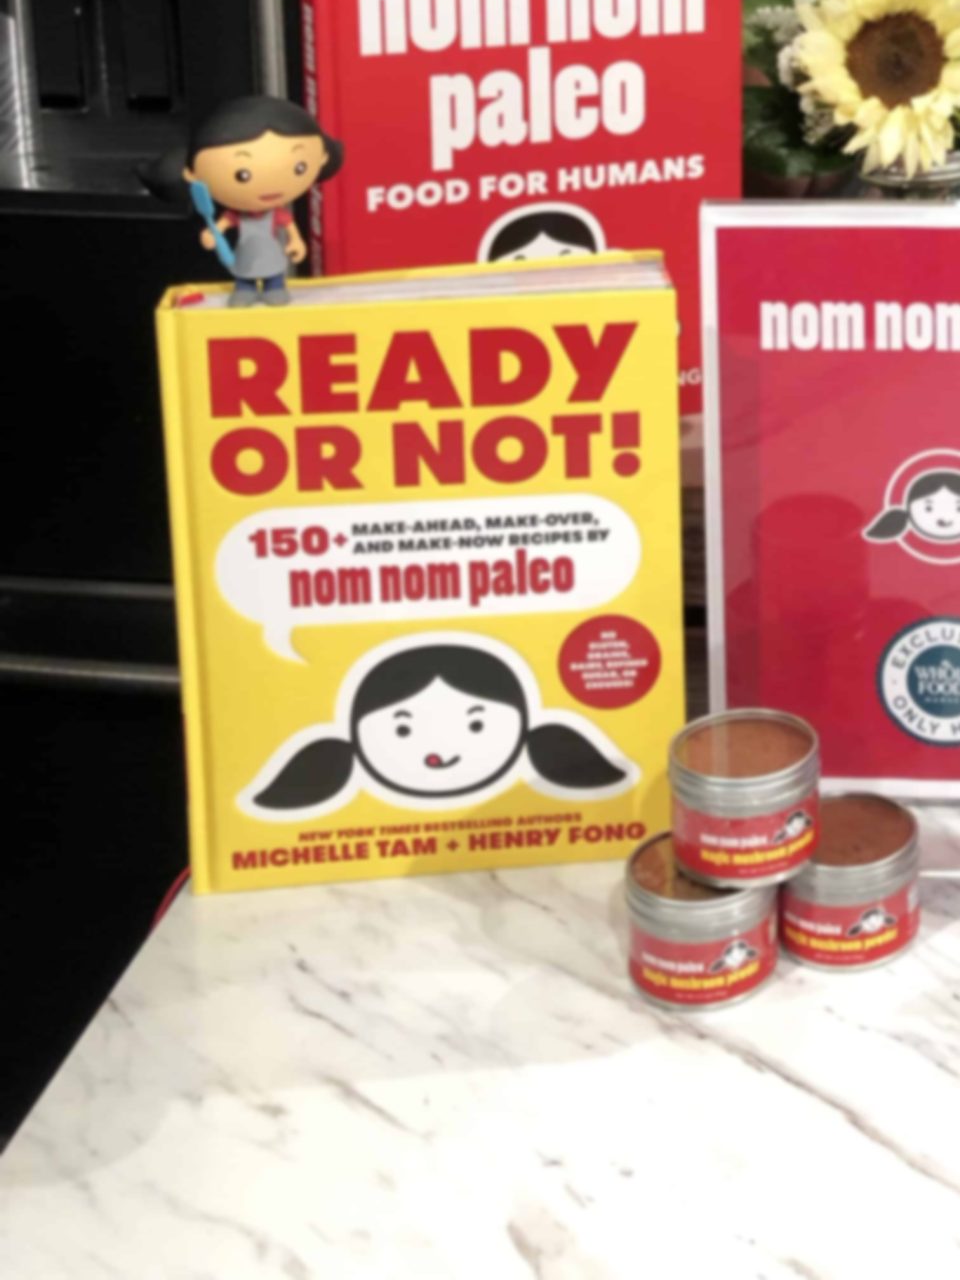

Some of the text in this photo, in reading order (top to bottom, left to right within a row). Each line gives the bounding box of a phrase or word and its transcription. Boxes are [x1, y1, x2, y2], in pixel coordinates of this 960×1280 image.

[429, 45, 645, 172] paleo
[367, 154, 705, 212] FOOD FOR HUMANS
[760, 300, 865, 351] nom
[207, 321, 639, 419] READY
[209, 411, 641, 496] OR NOT!
[248, 526, 348, 558] 150+
[351, 511, 600, 536] MAKE-AHEAD, MAKE-OVER,
[353, 529, 610, 554] AND MAKE-NOW RECIPES BY
[289, 548, 575, 608] nom nom paleo
[892, 695, 940, 734] ONLY
[232, 838, 370, 870] MICHELLE
[376, 836, 437, 857] TAM
[469, 827, 561, 850] HENRY
[569, 822, 646, 845] FONG
[299, 831, 332, 841] NEW
[338, 827, 374, 838] YORK
[380, 824, 420, 835] TIMES
